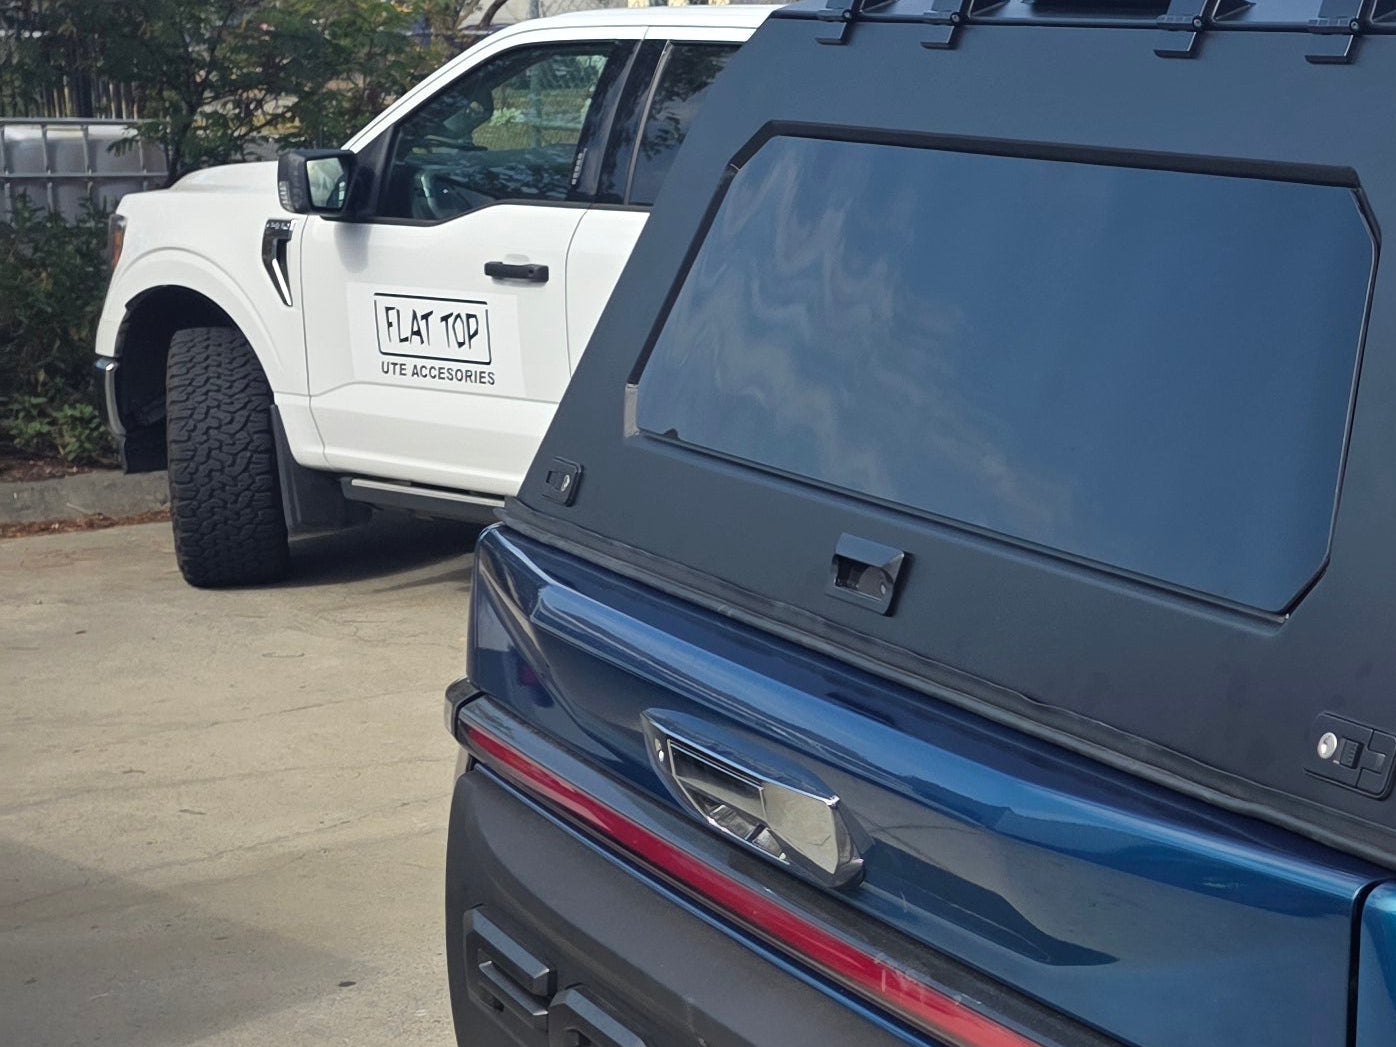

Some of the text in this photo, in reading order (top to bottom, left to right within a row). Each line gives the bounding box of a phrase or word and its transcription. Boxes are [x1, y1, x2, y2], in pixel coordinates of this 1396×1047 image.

[384, 306, 479, 350] FLAT TOP
[381, 361, 496, 385] UTE ACCESORIES
